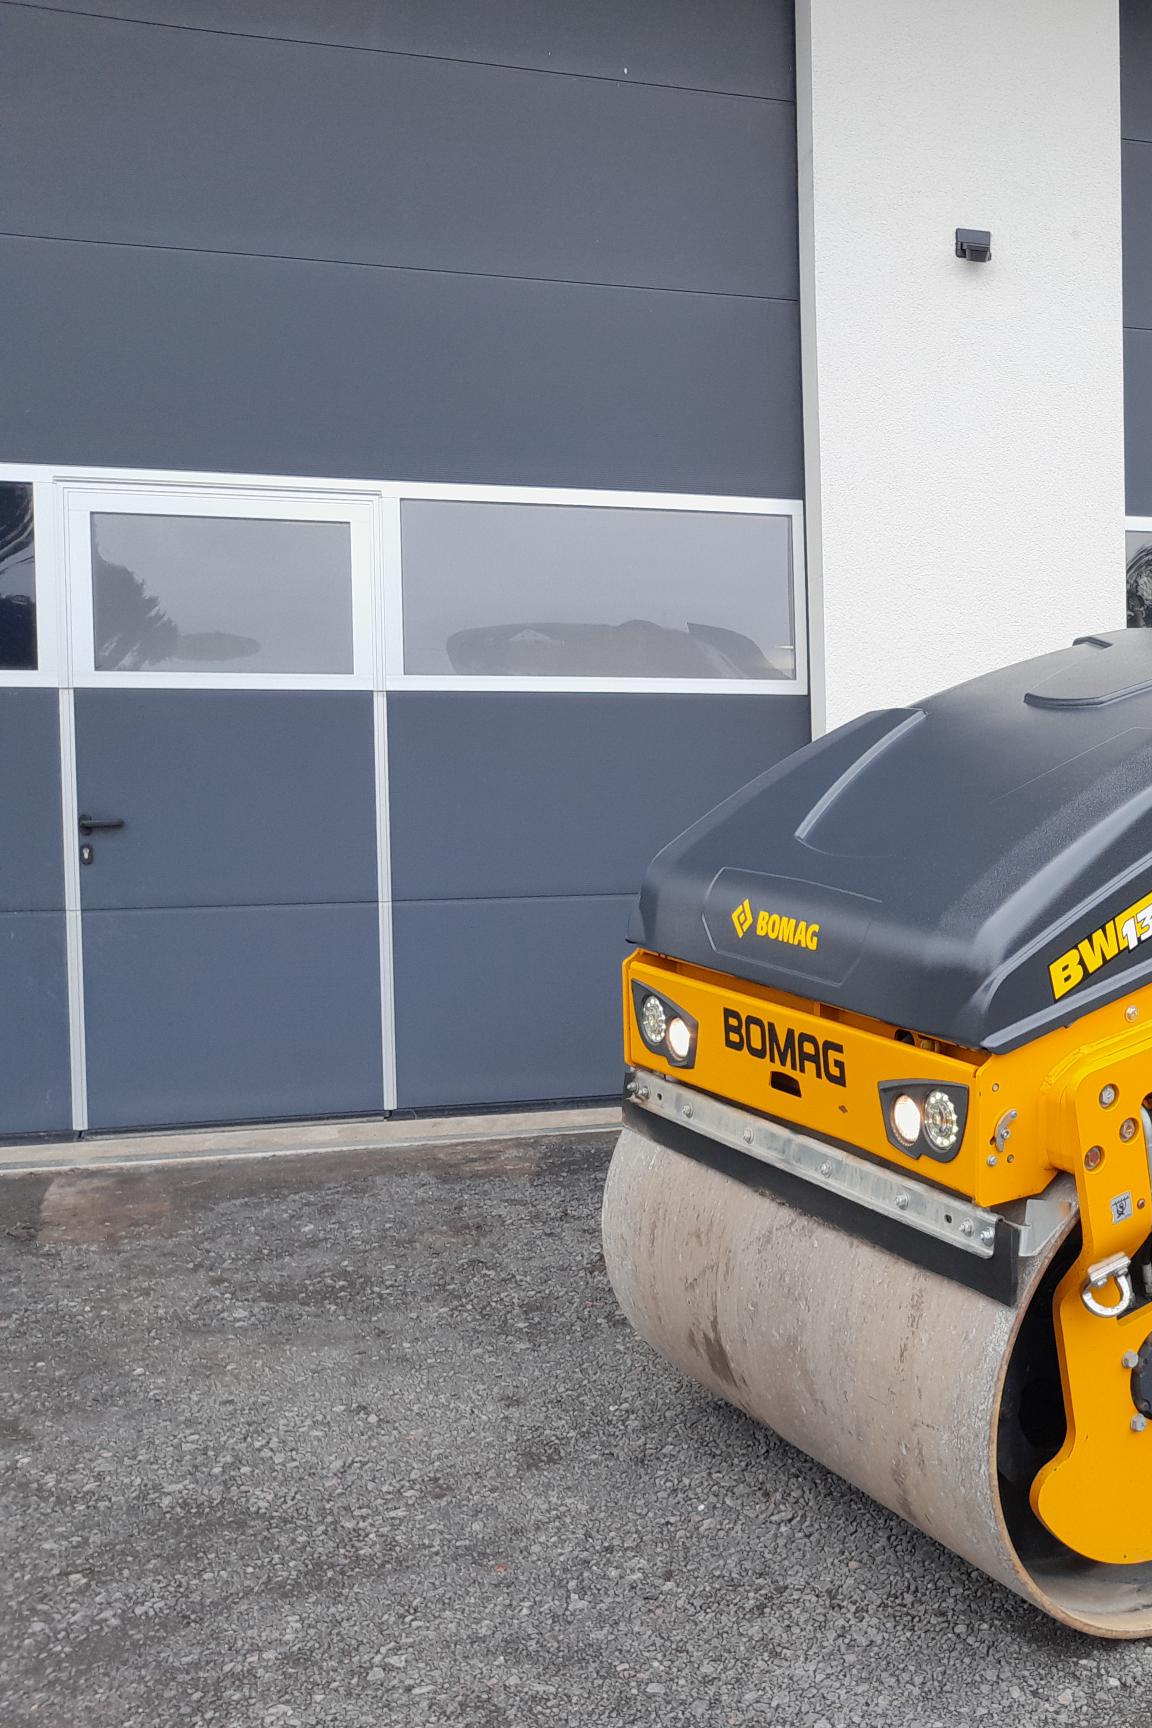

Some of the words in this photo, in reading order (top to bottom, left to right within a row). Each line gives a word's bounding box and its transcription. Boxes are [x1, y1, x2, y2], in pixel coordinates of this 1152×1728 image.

[756, 910, 820, 951] BOMAG
[1049, 919, 1117, 1001] BW
[723, 1007, 847, 1088] BOMAG
